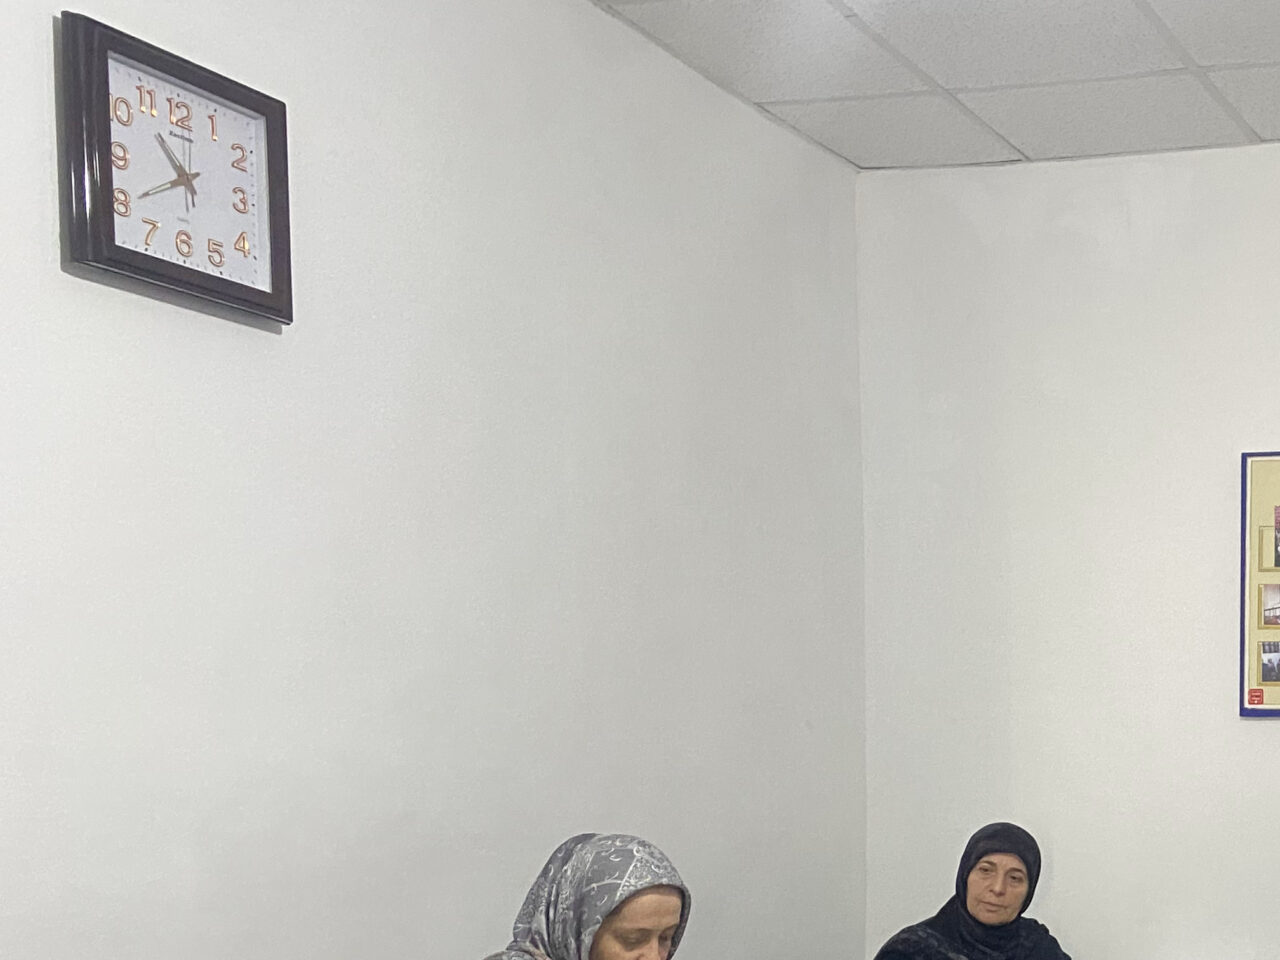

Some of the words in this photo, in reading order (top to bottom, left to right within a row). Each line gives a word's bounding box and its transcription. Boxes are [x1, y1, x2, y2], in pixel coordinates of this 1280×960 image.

[136, 85, 157, 118] 11
[166, 97, 193, 132] 12
[208, 115, 218, 141] 1
[112, 141, 130, 170] 9
[231, 143, 248, 173] 2
[113, 188, 131, 217] 8
[232, 186, 248, 214] 3
[142, 217, 162, 246] 7
[176, 229, 192, 258] 6
[234, 231, 250, 258] 4
[207, 238, 225, 268] 5
